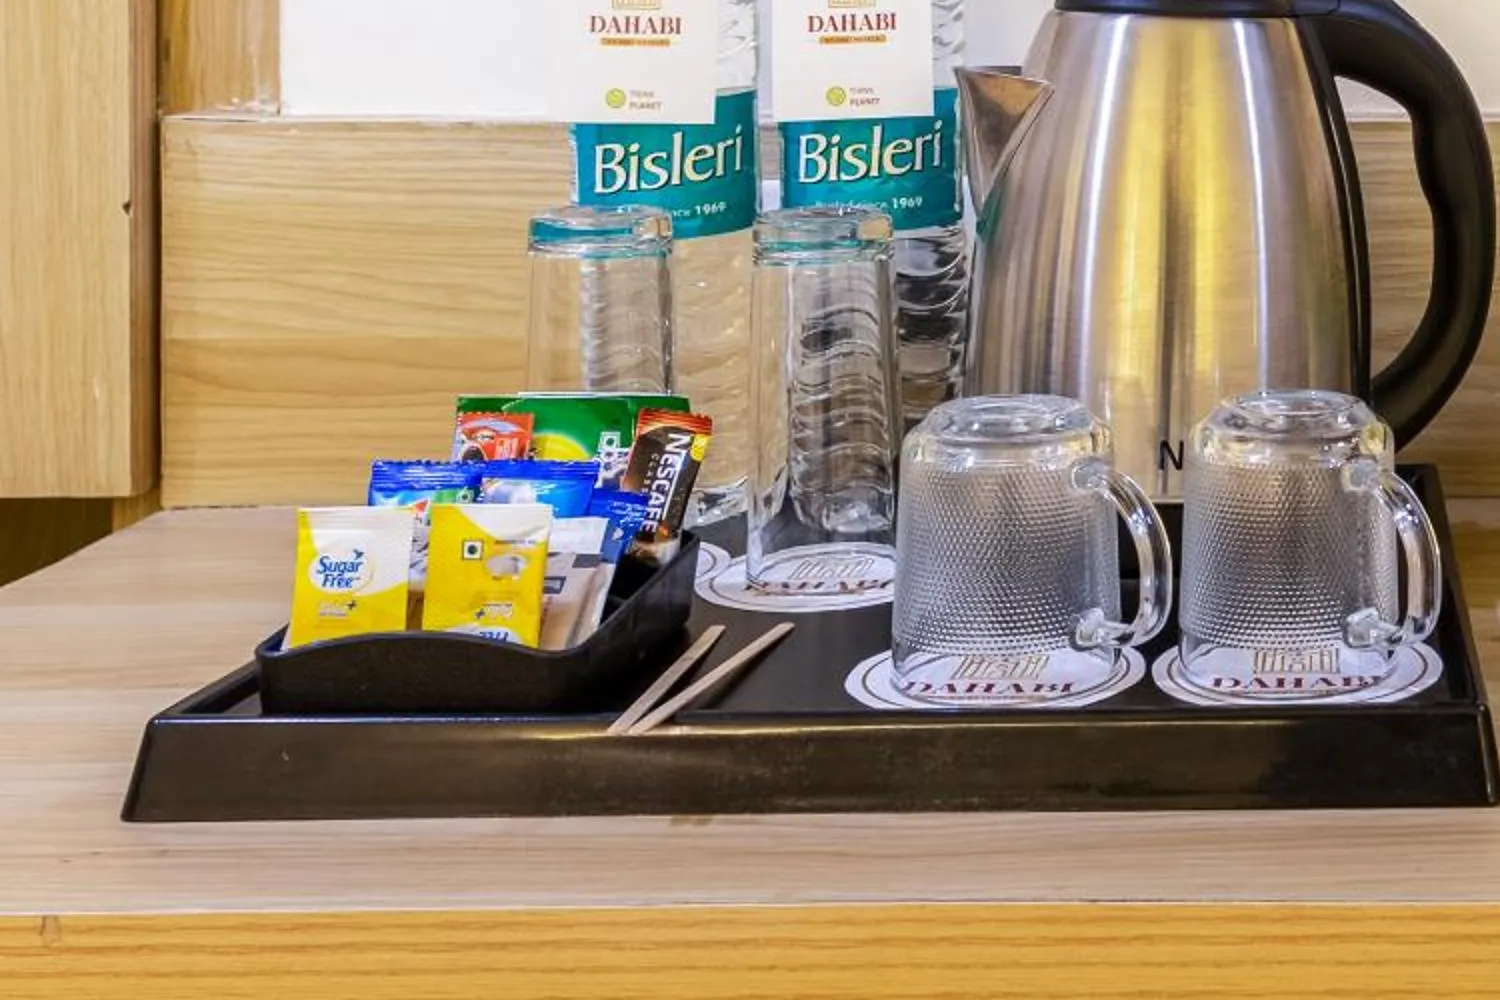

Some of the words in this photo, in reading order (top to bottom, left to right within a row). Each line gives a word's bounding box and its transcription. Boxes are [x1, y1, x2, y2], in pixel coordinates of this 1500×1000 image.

[590, 15, 682, 35] DAHABI
[807, 12, 897, 32] DAHABI
[594, 124, 743, 194] Bisleri
[798, 120, 944, 185] Bisleri
[694, 201, 728, 215] 1969
[892, 196, 923, 209] 1969
[316, 555, 365, 574] Sugar
[321, 573, 354, 588] Free
